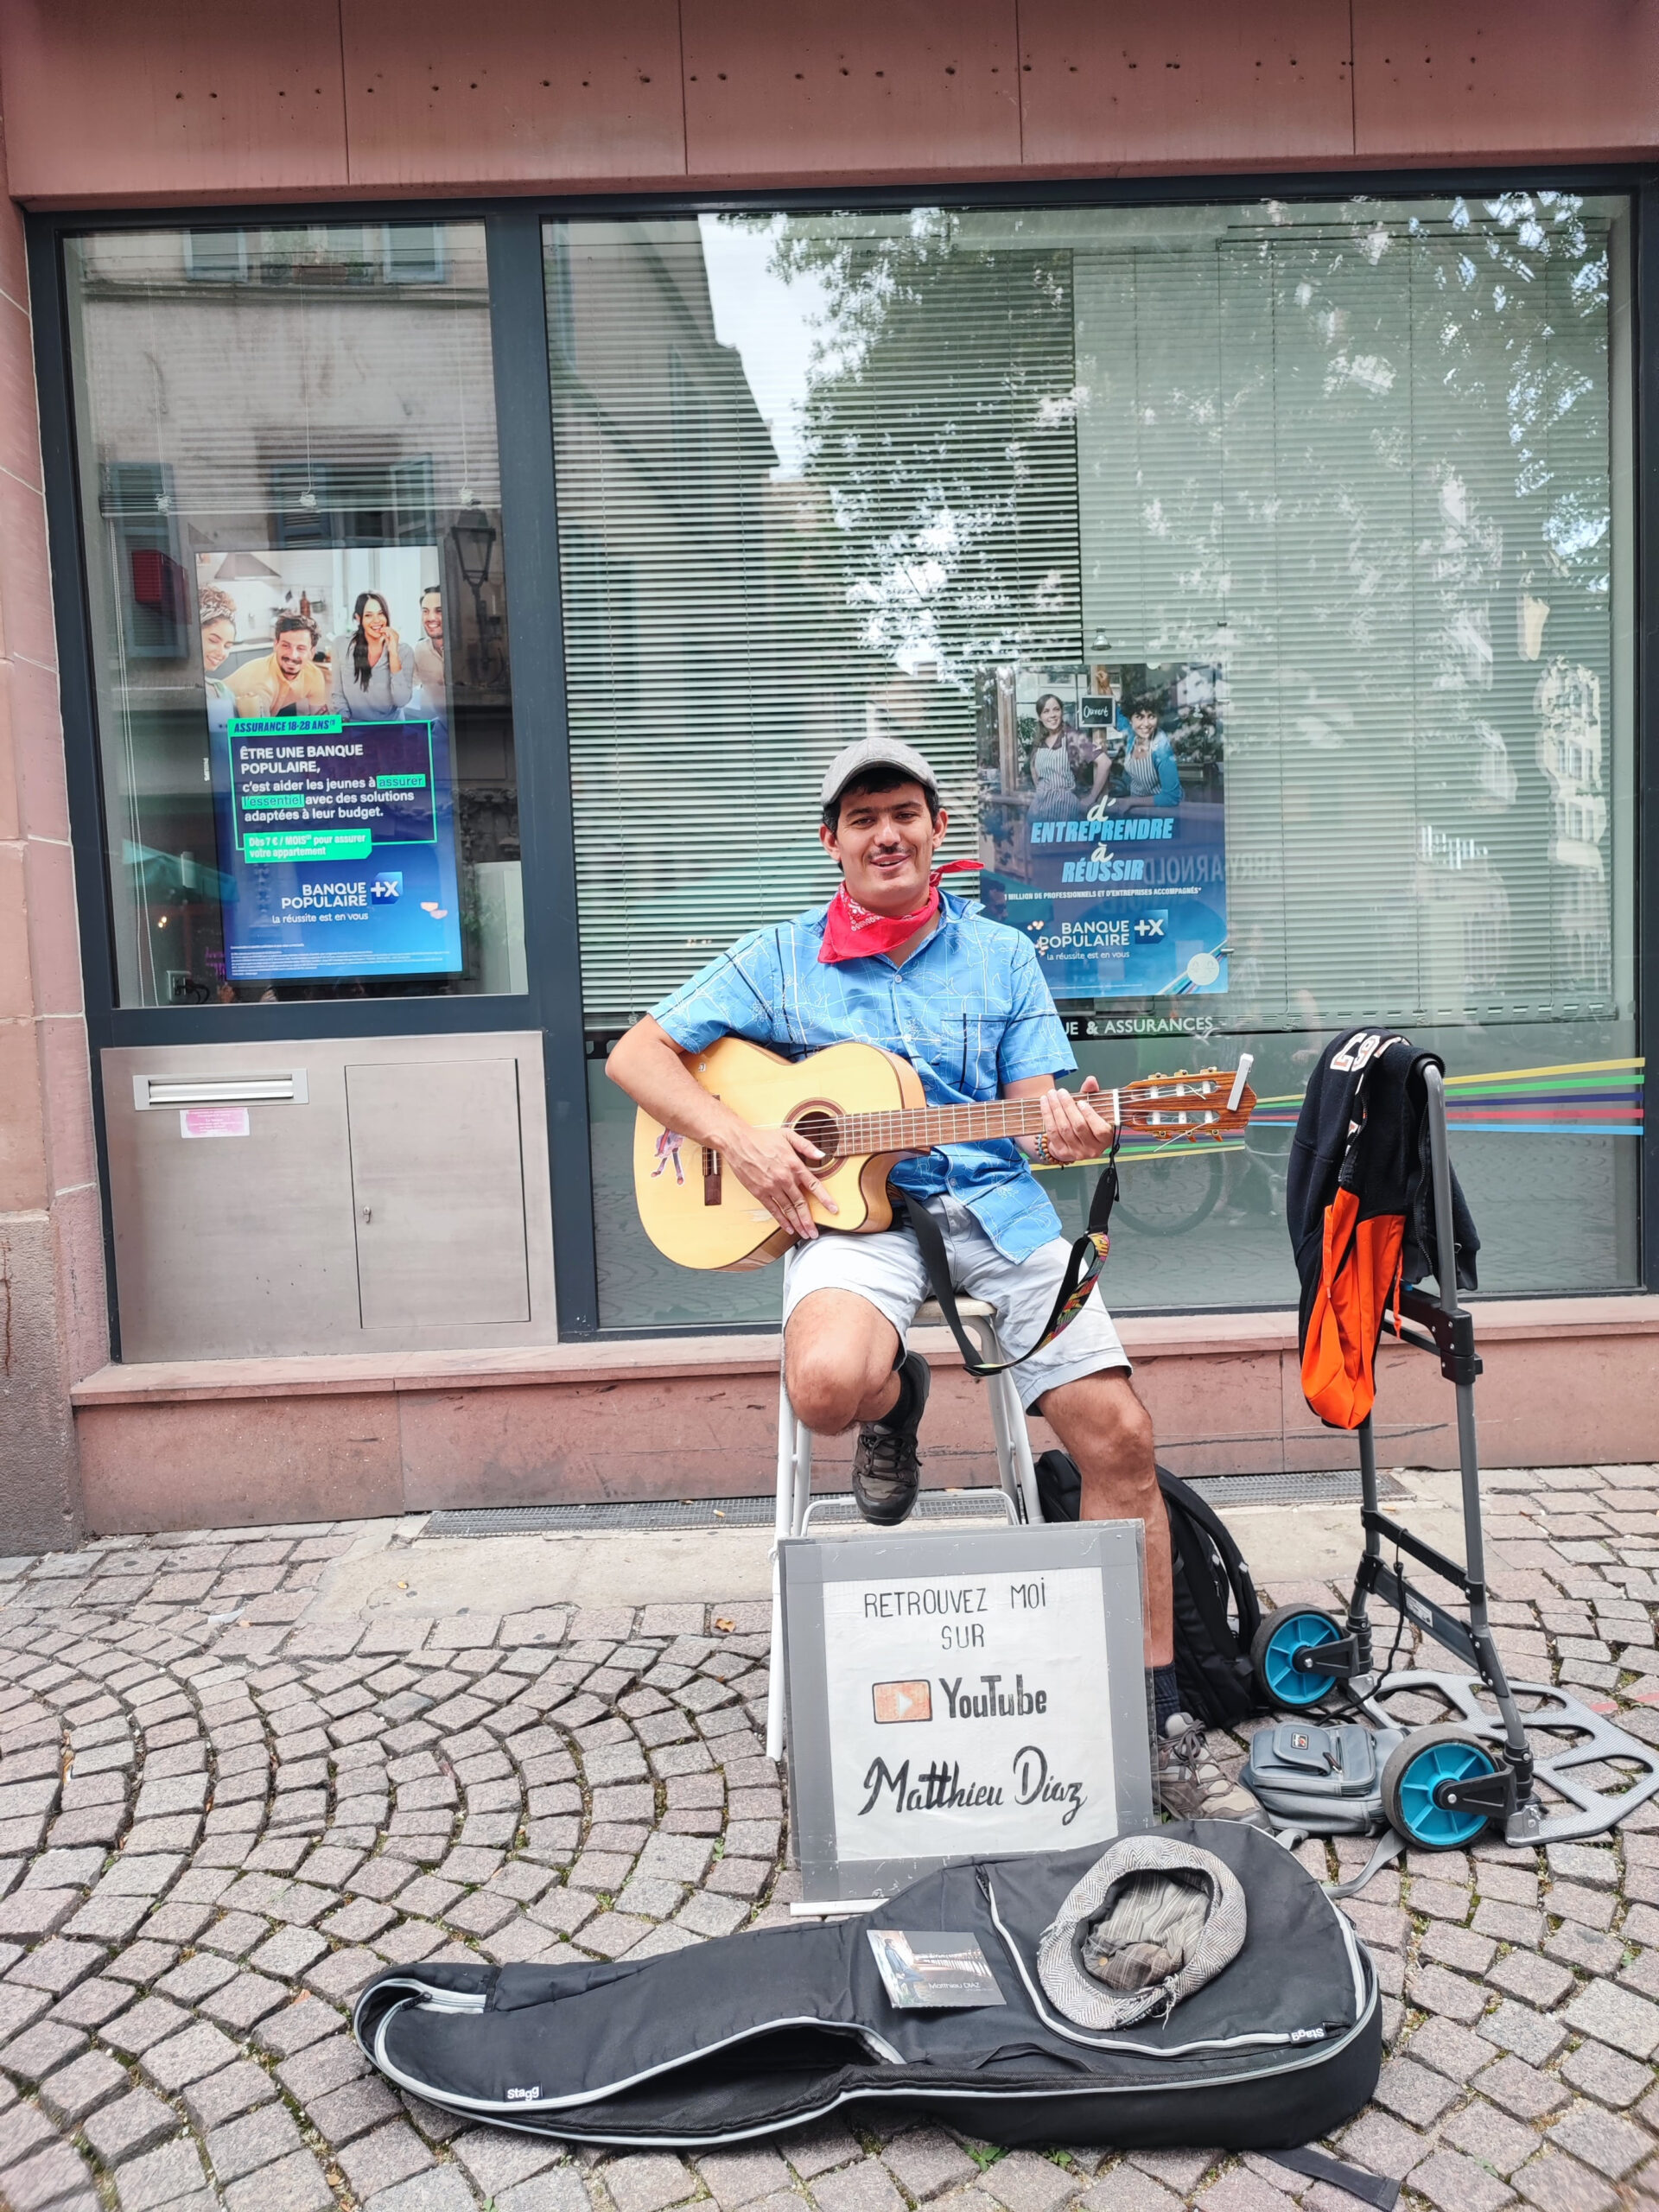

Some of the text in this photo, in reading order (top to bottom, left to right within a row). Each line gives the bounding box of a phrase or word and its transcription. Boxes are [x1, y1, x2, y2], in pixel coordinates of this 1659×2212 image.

[1083, 704, 1109, 719] Ouvert
[234, 721, 286, 734] ASSURANCE
[288, 720, 311, 732] 18-28
[239, 744, 364, 760] ÊTRE UNE BANQUE
[240, 760, 321, 775] POPULAIRE,
[242, 775, 423, 792] c'est aider les jeunes à assurer
[243, 789, 415, 807] l'essentiel avec des solutions
[244, 805, 384, 823] adaptées à leur budget.
[1030, 817, 1174, 843] ENTREPRENDRE
[249, 835, 266, 847] Dès
[266, 836, 270, 847] 7
[313, 836, 334, 847] pour
[334, 835, 366, 844] assurer
[249, 846, 327, 859] votre appartement
[1090, 842, 1115, 862] à
[1061, 856, 1145, 883] RÉUSSIR
[302, 881, 367, 896] BANQUE
[1043, 889, 1096, 899] PROFESSIONNELS
[1096, 889, 1105, 898] ET
[281, 894, 368, 910] POPULAIRE
[271, 914, 281, 924] la
[283, 912, 317, 924] réussite
[318, 912, 333, 922] est
[346, 912, 369, 921] vous
[1061, 920, 1130, 935] BANQUE
[1039, 933, 1130, 949] POPULAIRE
[1055, 951, 1085, 961] réussite
[1086, 950, 1100, 959] est
[1086, 1020, 1099, 1035] &
[1104, 1016, 1213, 1034] ASSURANCES
[864, 1587, 988, 1618] RETROUVEZ
[941, 1623, 985, 1650] SUR
[938, 1674, 1047, 1719] YouTube
[857, 1745, 1088, 1827] Matthieu Diaz
[1291, 2027, 1325, 2041] Stagg
[506, 2086, 540, 2101] Stagg
